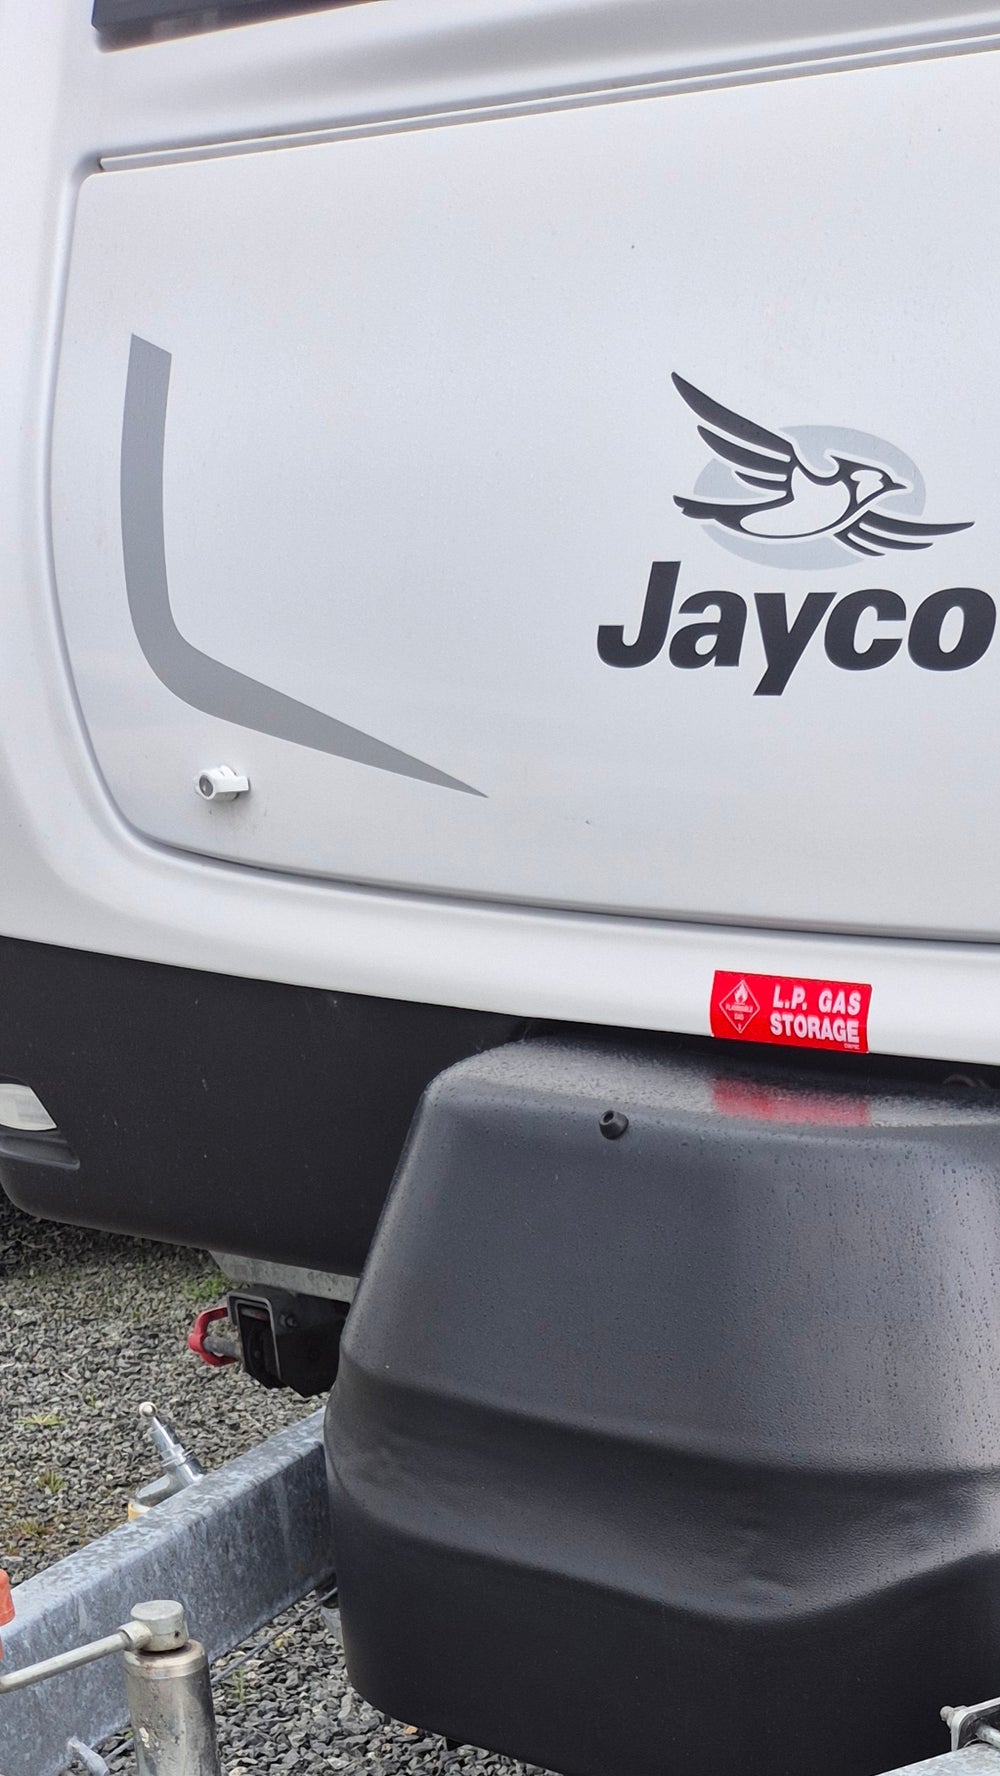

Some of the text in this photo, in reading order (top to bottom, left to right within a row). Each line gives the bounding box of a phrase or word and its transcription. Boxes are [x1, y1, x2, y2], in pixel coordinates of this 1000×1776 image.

[596, 561, 997, 697] Jayco
[772, 984, 861, 1016] L.P. GAS
[770, 1010, 860, 1044] STORAGE
